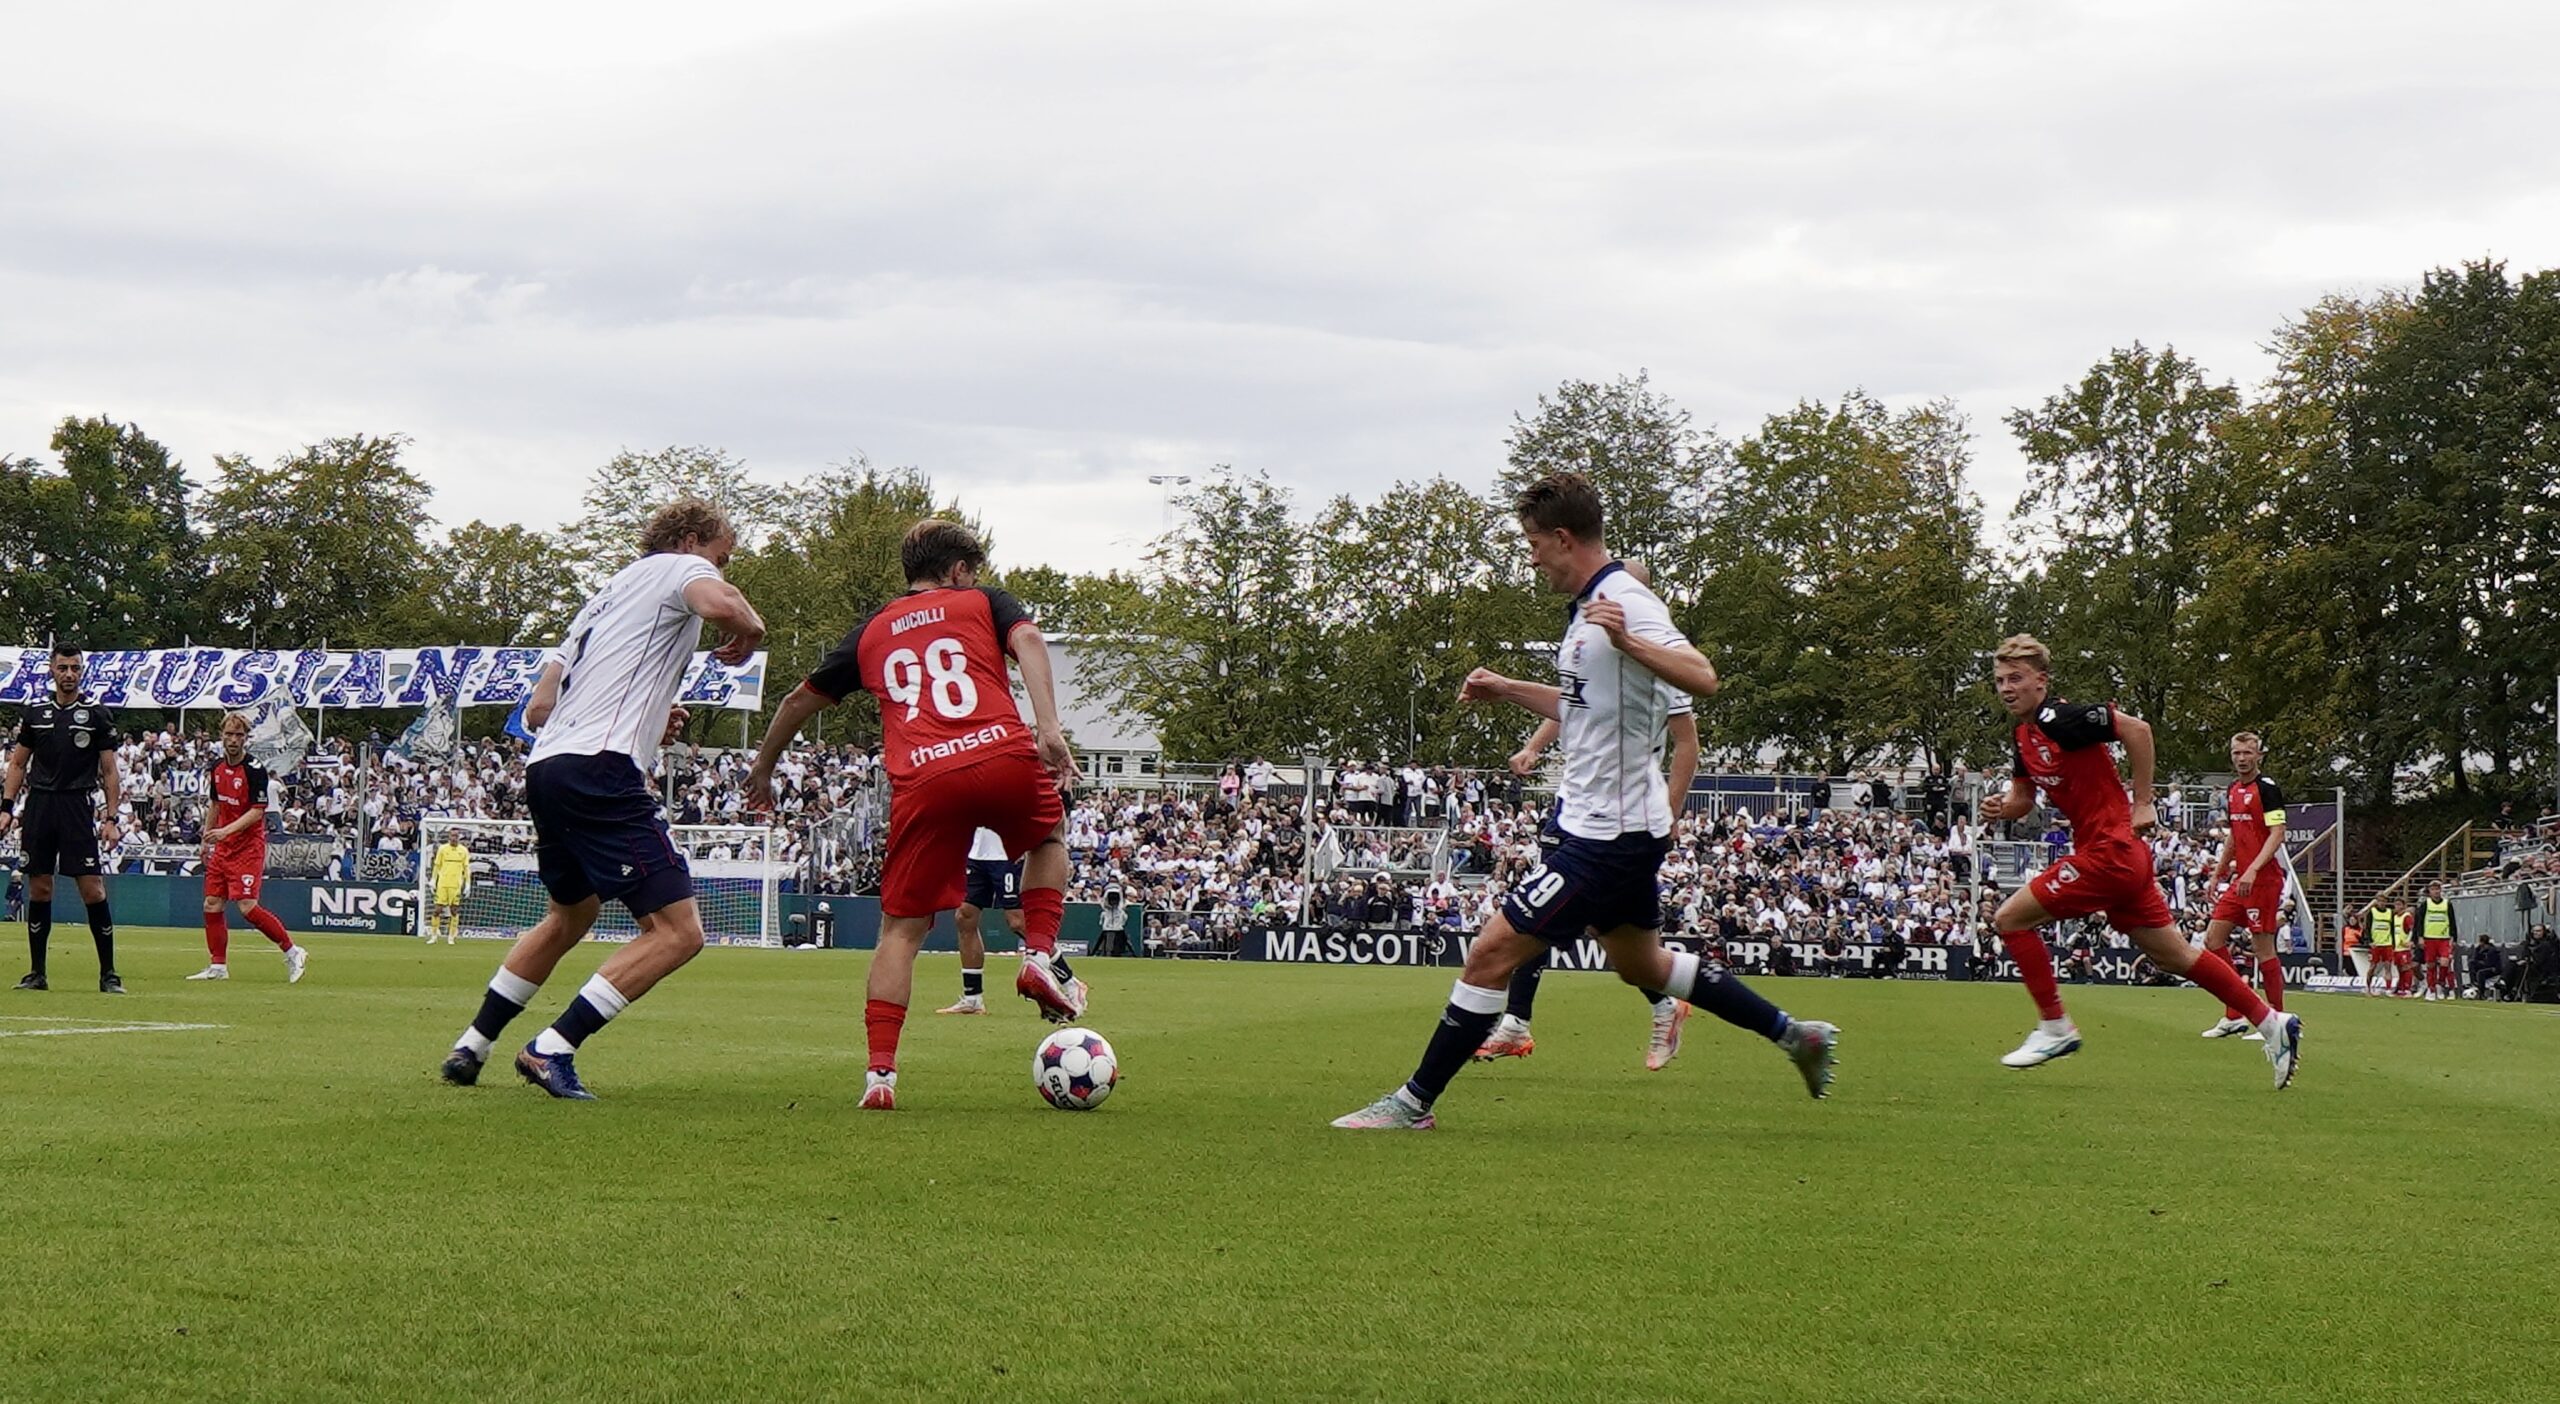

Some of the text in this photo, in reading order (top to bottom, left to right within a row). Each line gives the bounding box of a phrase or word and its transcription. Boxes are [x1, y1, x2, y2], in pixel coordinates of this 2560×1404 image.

[891, 607, 945, 636] MUCOLLI
[883, 637, 978, 723] 98
[909, 724, 1008, 768] thansen
[2284, 829, 2316, 842] PARK
[1004, 872, 1014, 893] 9
[1515, 863, 1566, 908] 29
[311, 886, 411, 917] NRG
[311, 914, 376, 930] til handling
[1265, 930, 1424, 966] MASCOT
[1903, 947, 1949, 971] PR
